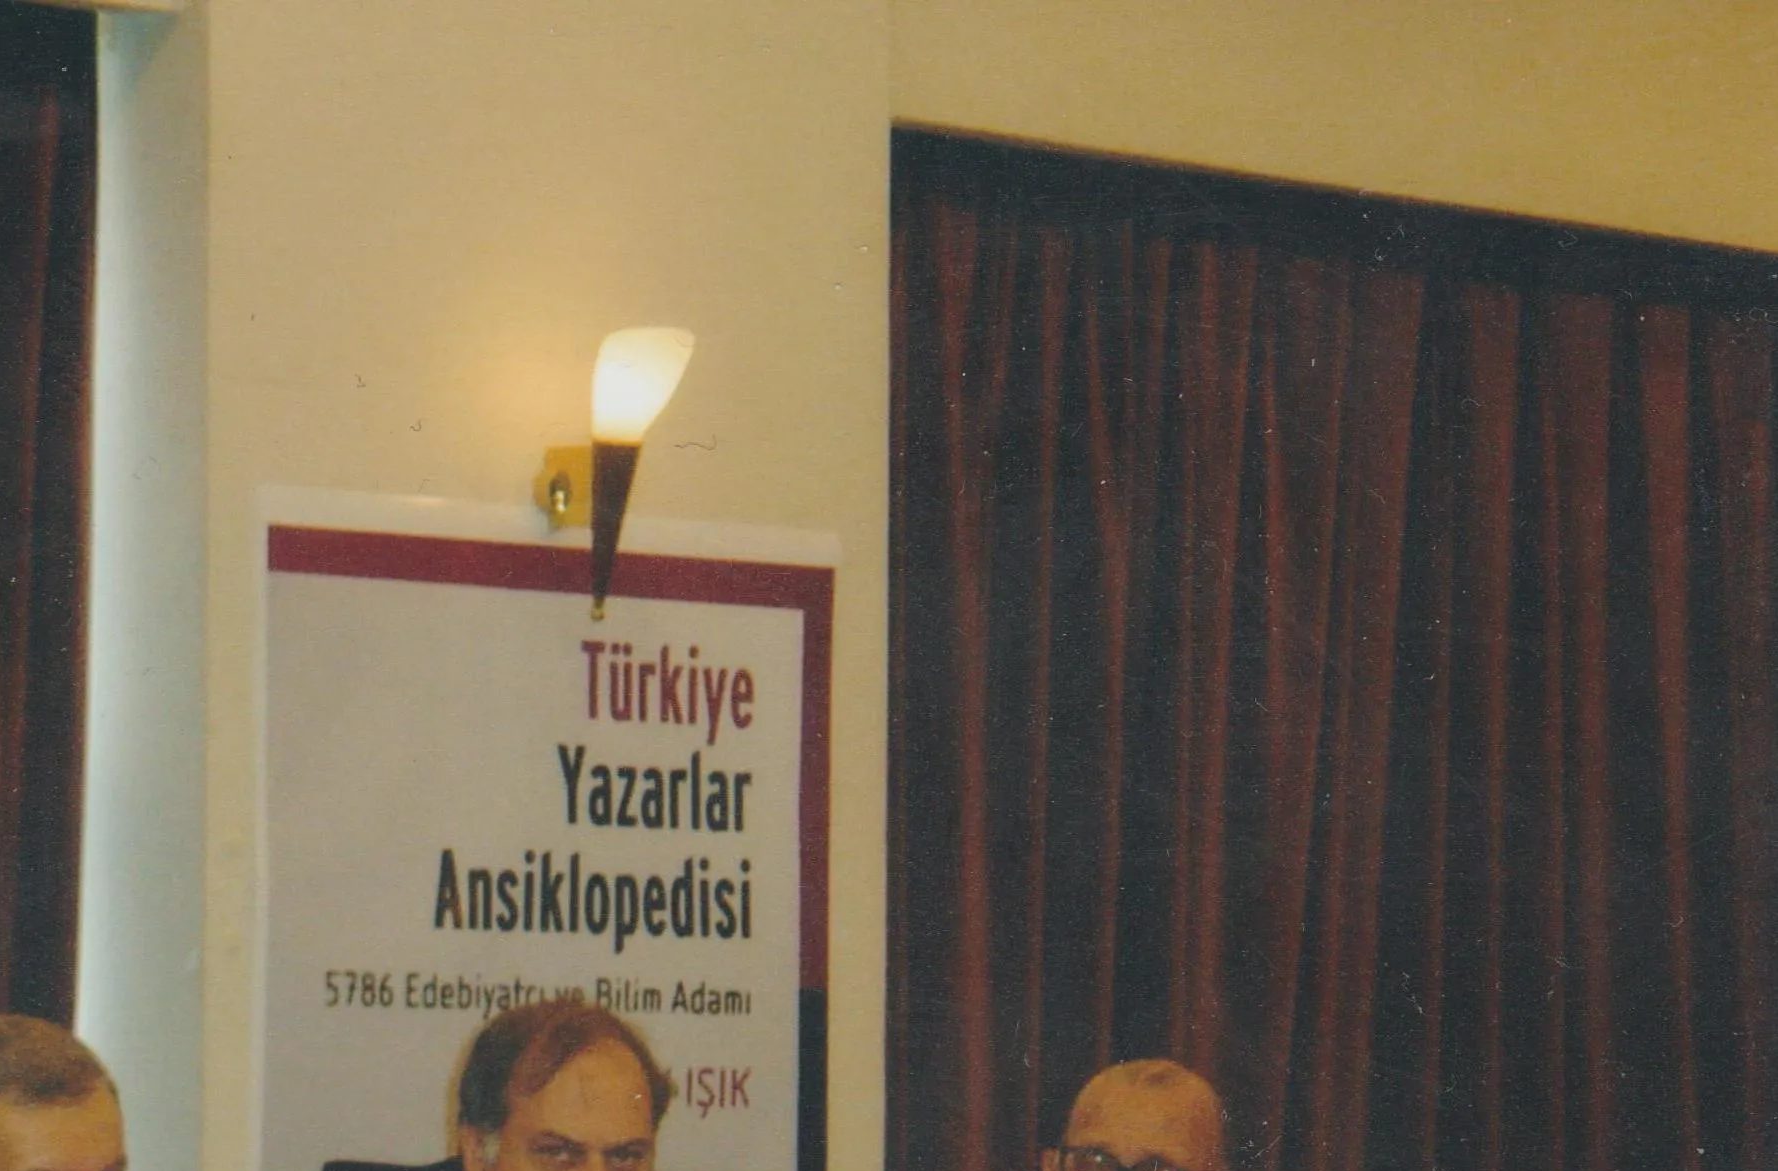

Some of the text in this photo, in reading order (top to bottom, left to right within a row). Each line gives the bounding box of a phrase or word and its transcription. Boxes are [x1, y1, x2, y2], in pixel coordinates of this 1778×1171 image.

[580, 639, 755, 746] Türkiye
[556, 743, 753, 832] Yazarlar
[434, 847, 753, 955] Ansiklopedisi
[325, 970, 394, 1007] 5786
[595, 977, 662, 1013] Bilim
[670, 980, 751, 1016] Adamı
[685, 1066, 752, 1118] IŞIK
